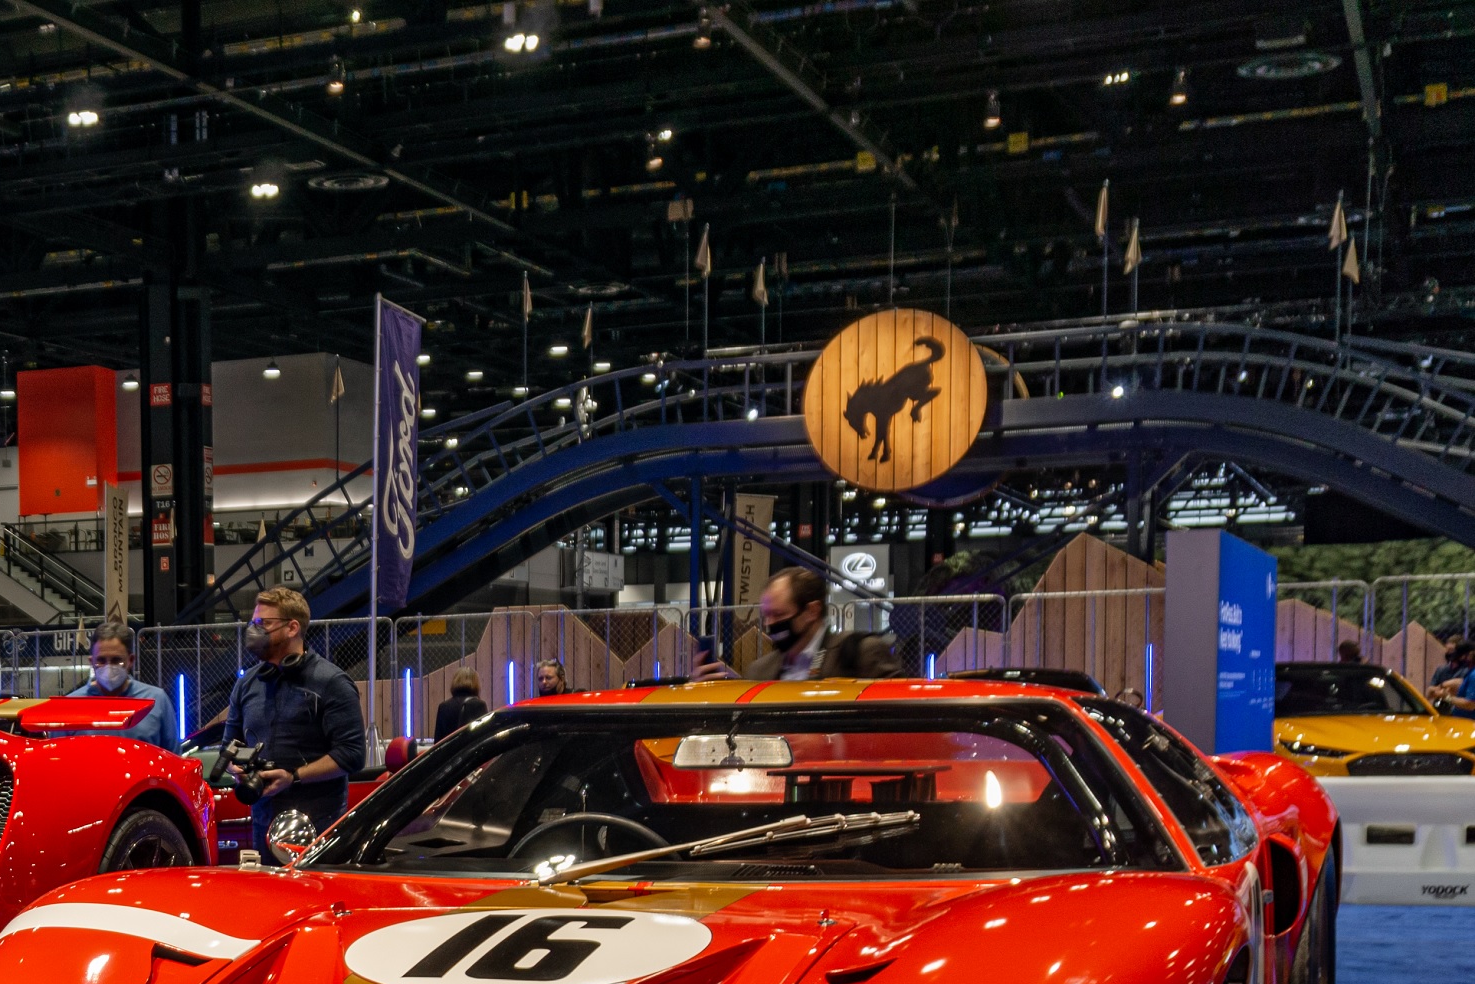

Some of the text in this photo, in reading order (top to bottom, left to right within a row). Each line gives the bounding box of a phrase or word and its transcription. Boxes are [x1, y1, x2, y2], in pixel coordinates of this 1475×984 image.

[383, 359, 415, 560] Ford
[739, 555, 752, 604] TWIST
[1421, 884, 1470, 895] YODOCK
[402, 914, 635, 982] 16
